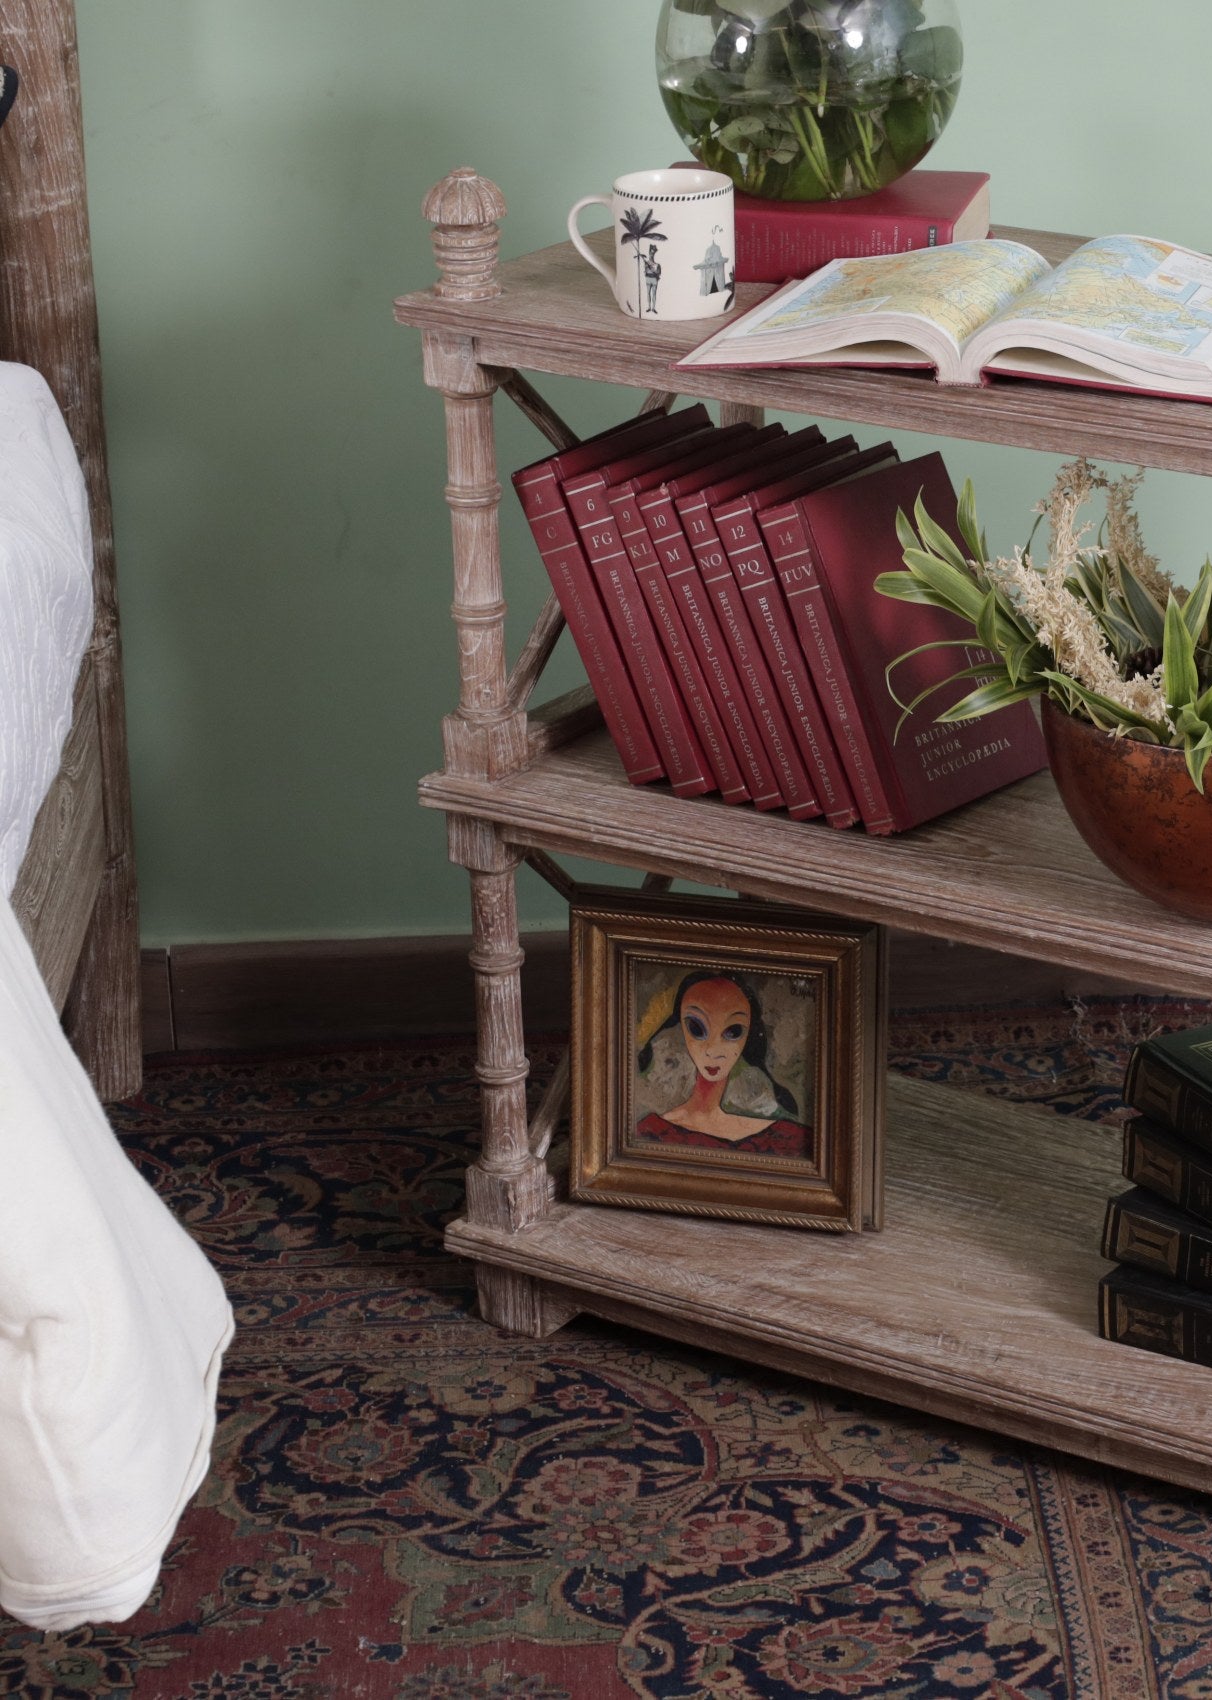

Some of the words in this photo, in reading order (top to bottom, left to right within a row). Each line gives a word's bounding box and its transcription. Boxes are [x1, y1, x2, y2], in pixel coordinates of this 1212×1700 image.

[535, 493, 542, 504] 4
[586, 498, 595, 511] 6
[622, 510, 631, 523] 9
[653, 514, 667, 529] 10
[546, 526, 557, 539] C
[692, 519, 706, 534] 11
[730, 525, 746, 540] 12
[592, 532, 613, 548] FG
[778, 531, 793, 546] 14
[666, 548, 680, 563] M
[699, 553, 722, 570] NO
[737, 559, 764, 577] PQ
[780, 563, 813, 584] TUV
[609, 569, 637, 639] BRITANNICA
[648, 579, 680, 649] BRITANNICA
[682, 584, 713, 653] BRITANNICA
[708, 655, 731, 699] JUNIOR
[718, 591, 748, 661] BRITANNICA
[742, 664, 765, 707] JUNIOR
[759, 596, 788, 668] BRITANNICA
[782, 669, 804, 713] JUNIOR
[805, 603, 832, 675] BRITANNICA
[826, 677, 848, 721] JUNIOR
[921, 738, 962, 769] JUNIOR
